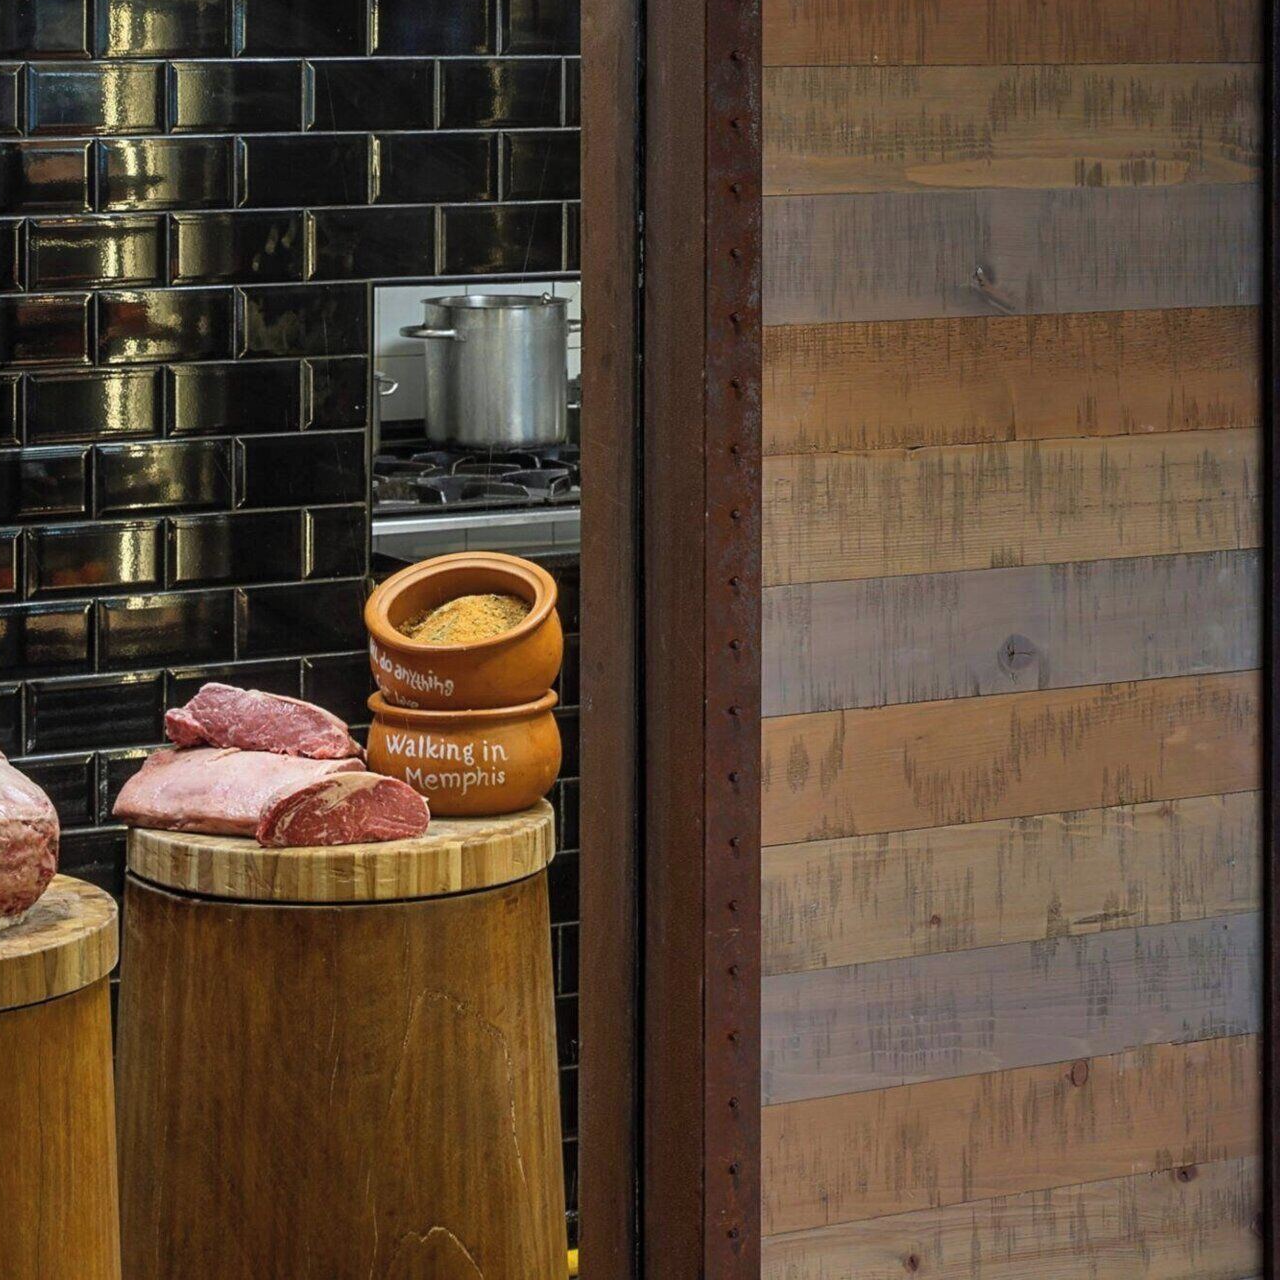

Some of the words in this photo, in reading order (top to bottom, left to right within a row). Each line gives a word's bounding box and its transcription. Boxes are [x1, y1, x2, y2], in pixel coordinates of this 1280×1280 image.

[380, 652, 393, 673] do
[394, 663, 454, 697] anything
[386, 733, 474, 765] Walking
[482, 739, 509, 763] in
[405, 766, 506, 796] Memphis
